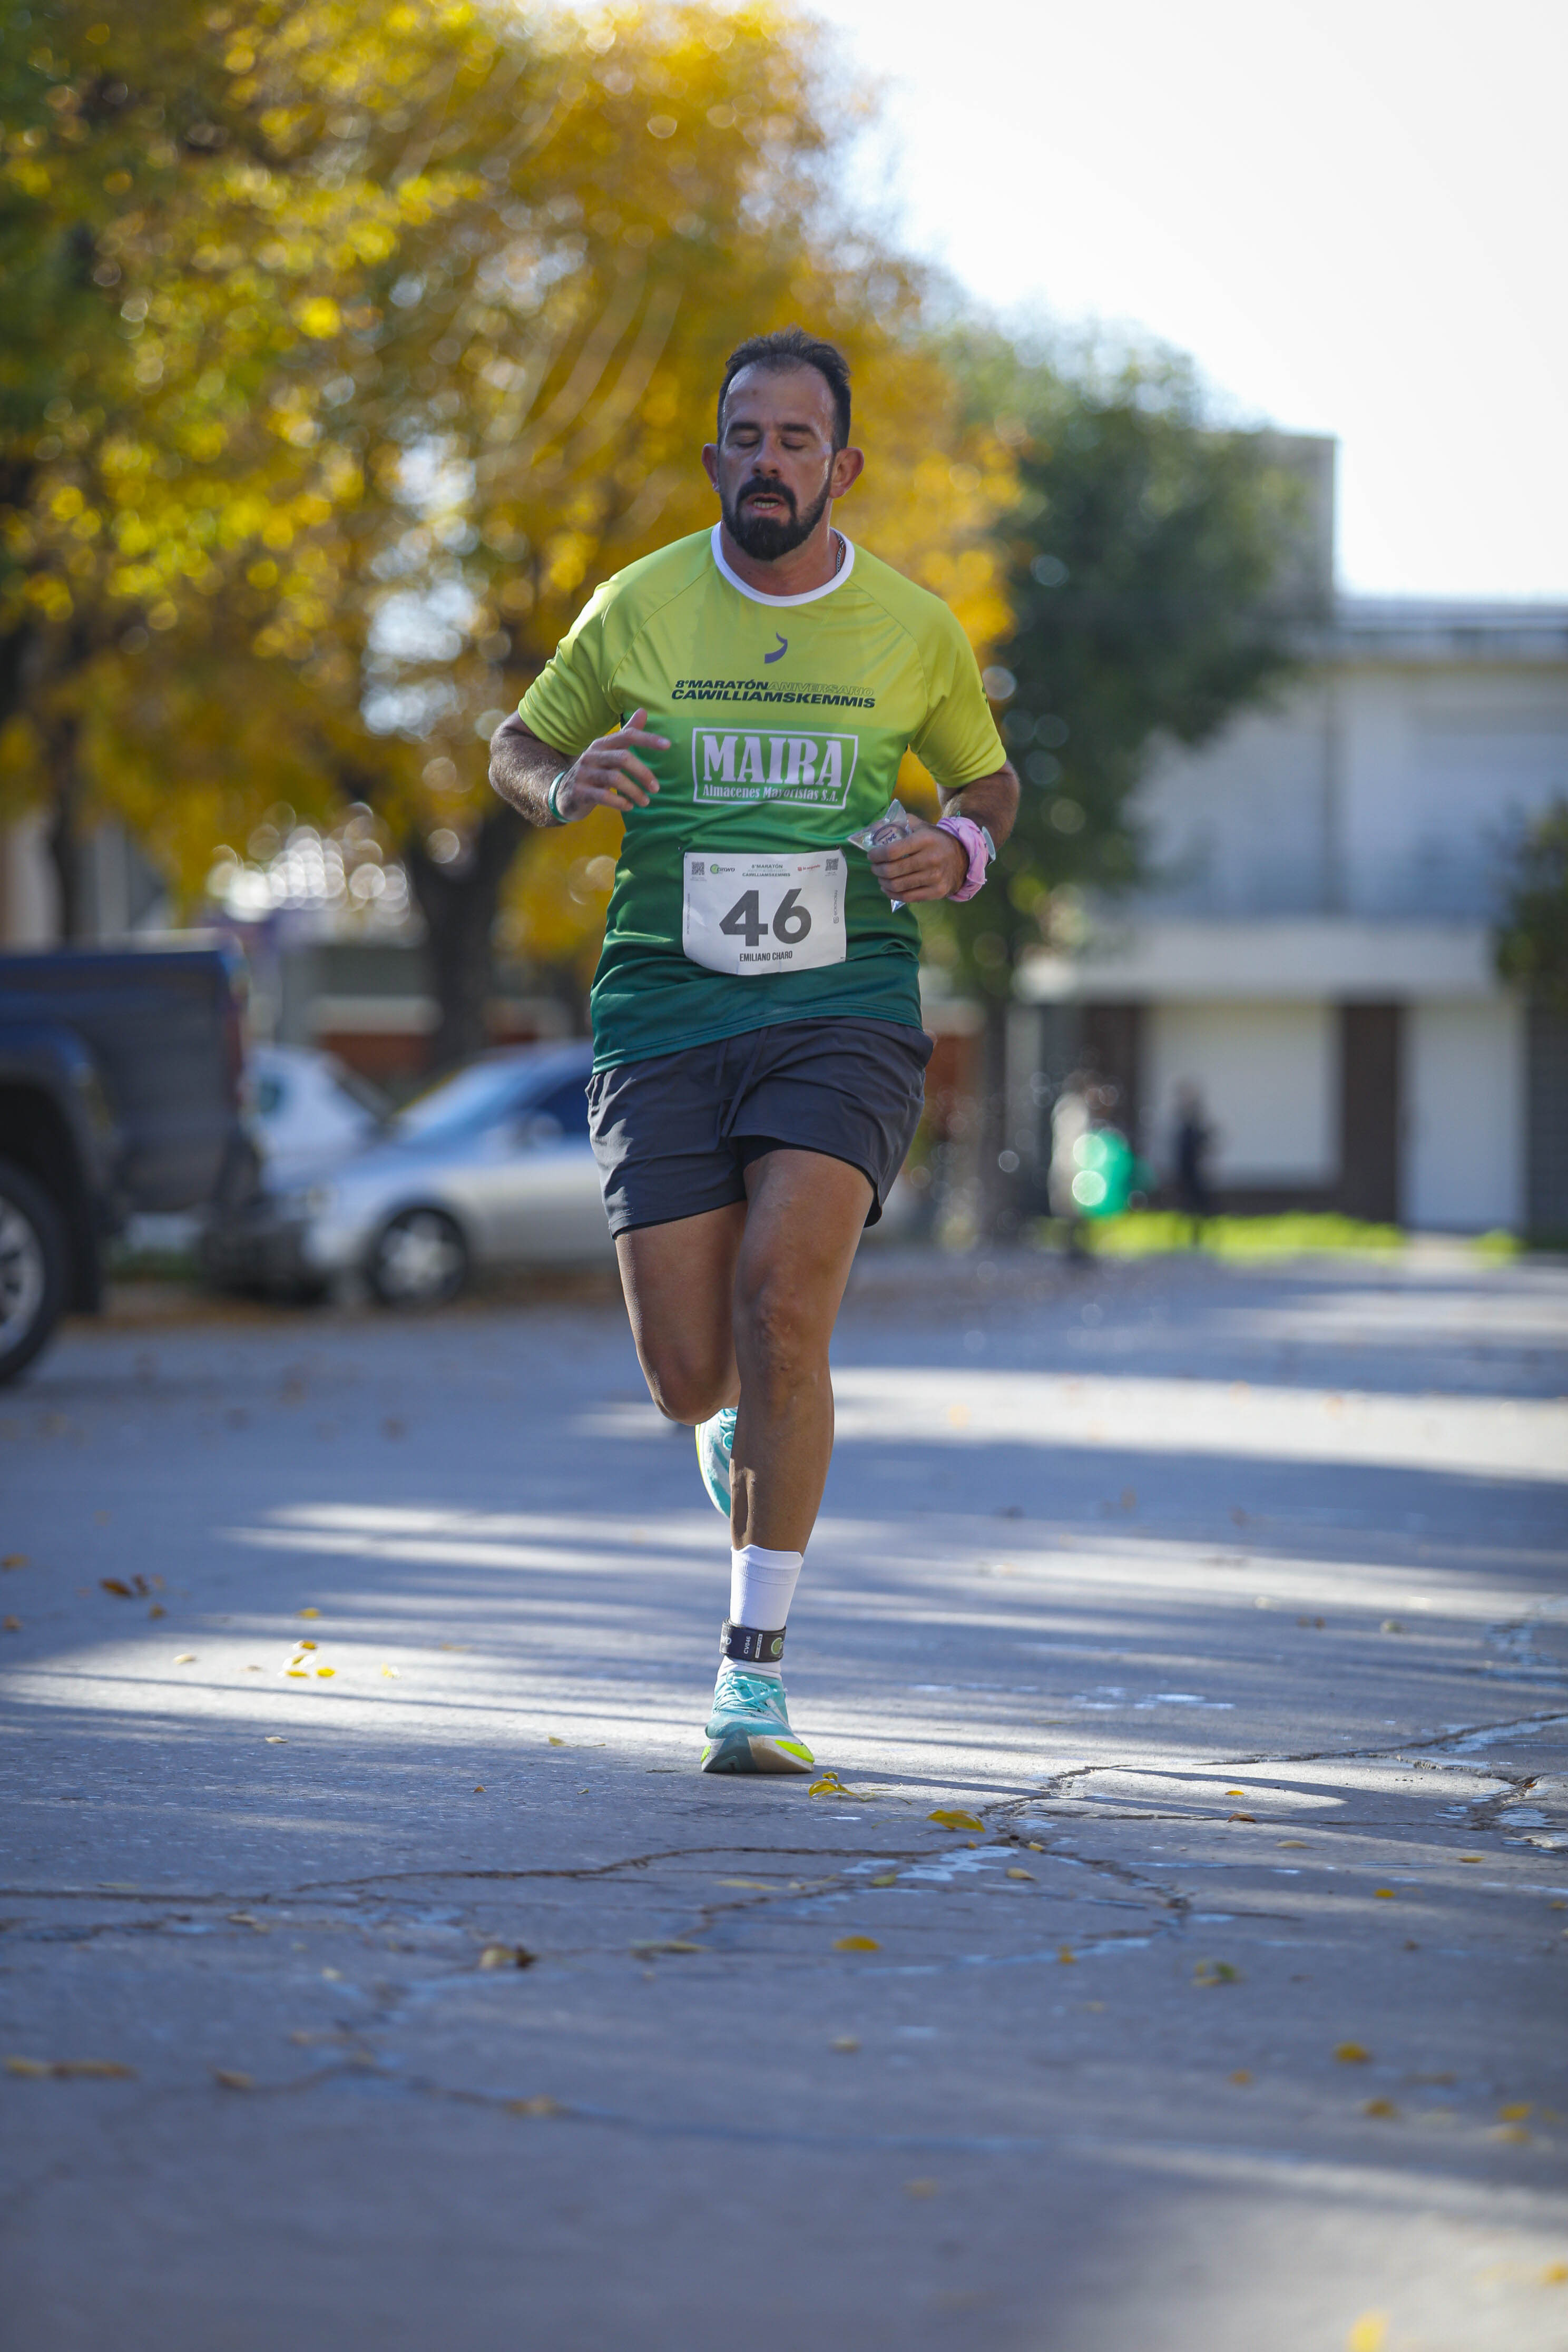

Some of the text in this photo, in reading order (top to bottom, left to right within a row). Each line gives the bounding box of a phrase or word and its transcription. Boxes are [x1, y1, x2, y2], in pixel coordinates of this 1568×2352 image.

[767, 681, 875, 697] ANIVERSARIO
[671, 689, 876, 709] CAWILLIAMSKEMMIS
[702, 735, 842, 788] MAIRA
[702, 784, 838, 802] Almacenes Mayoristas S.A.
[719, 888, 812, 947] 46
[739, 950, 793, 962] EMILIANO CHARO
